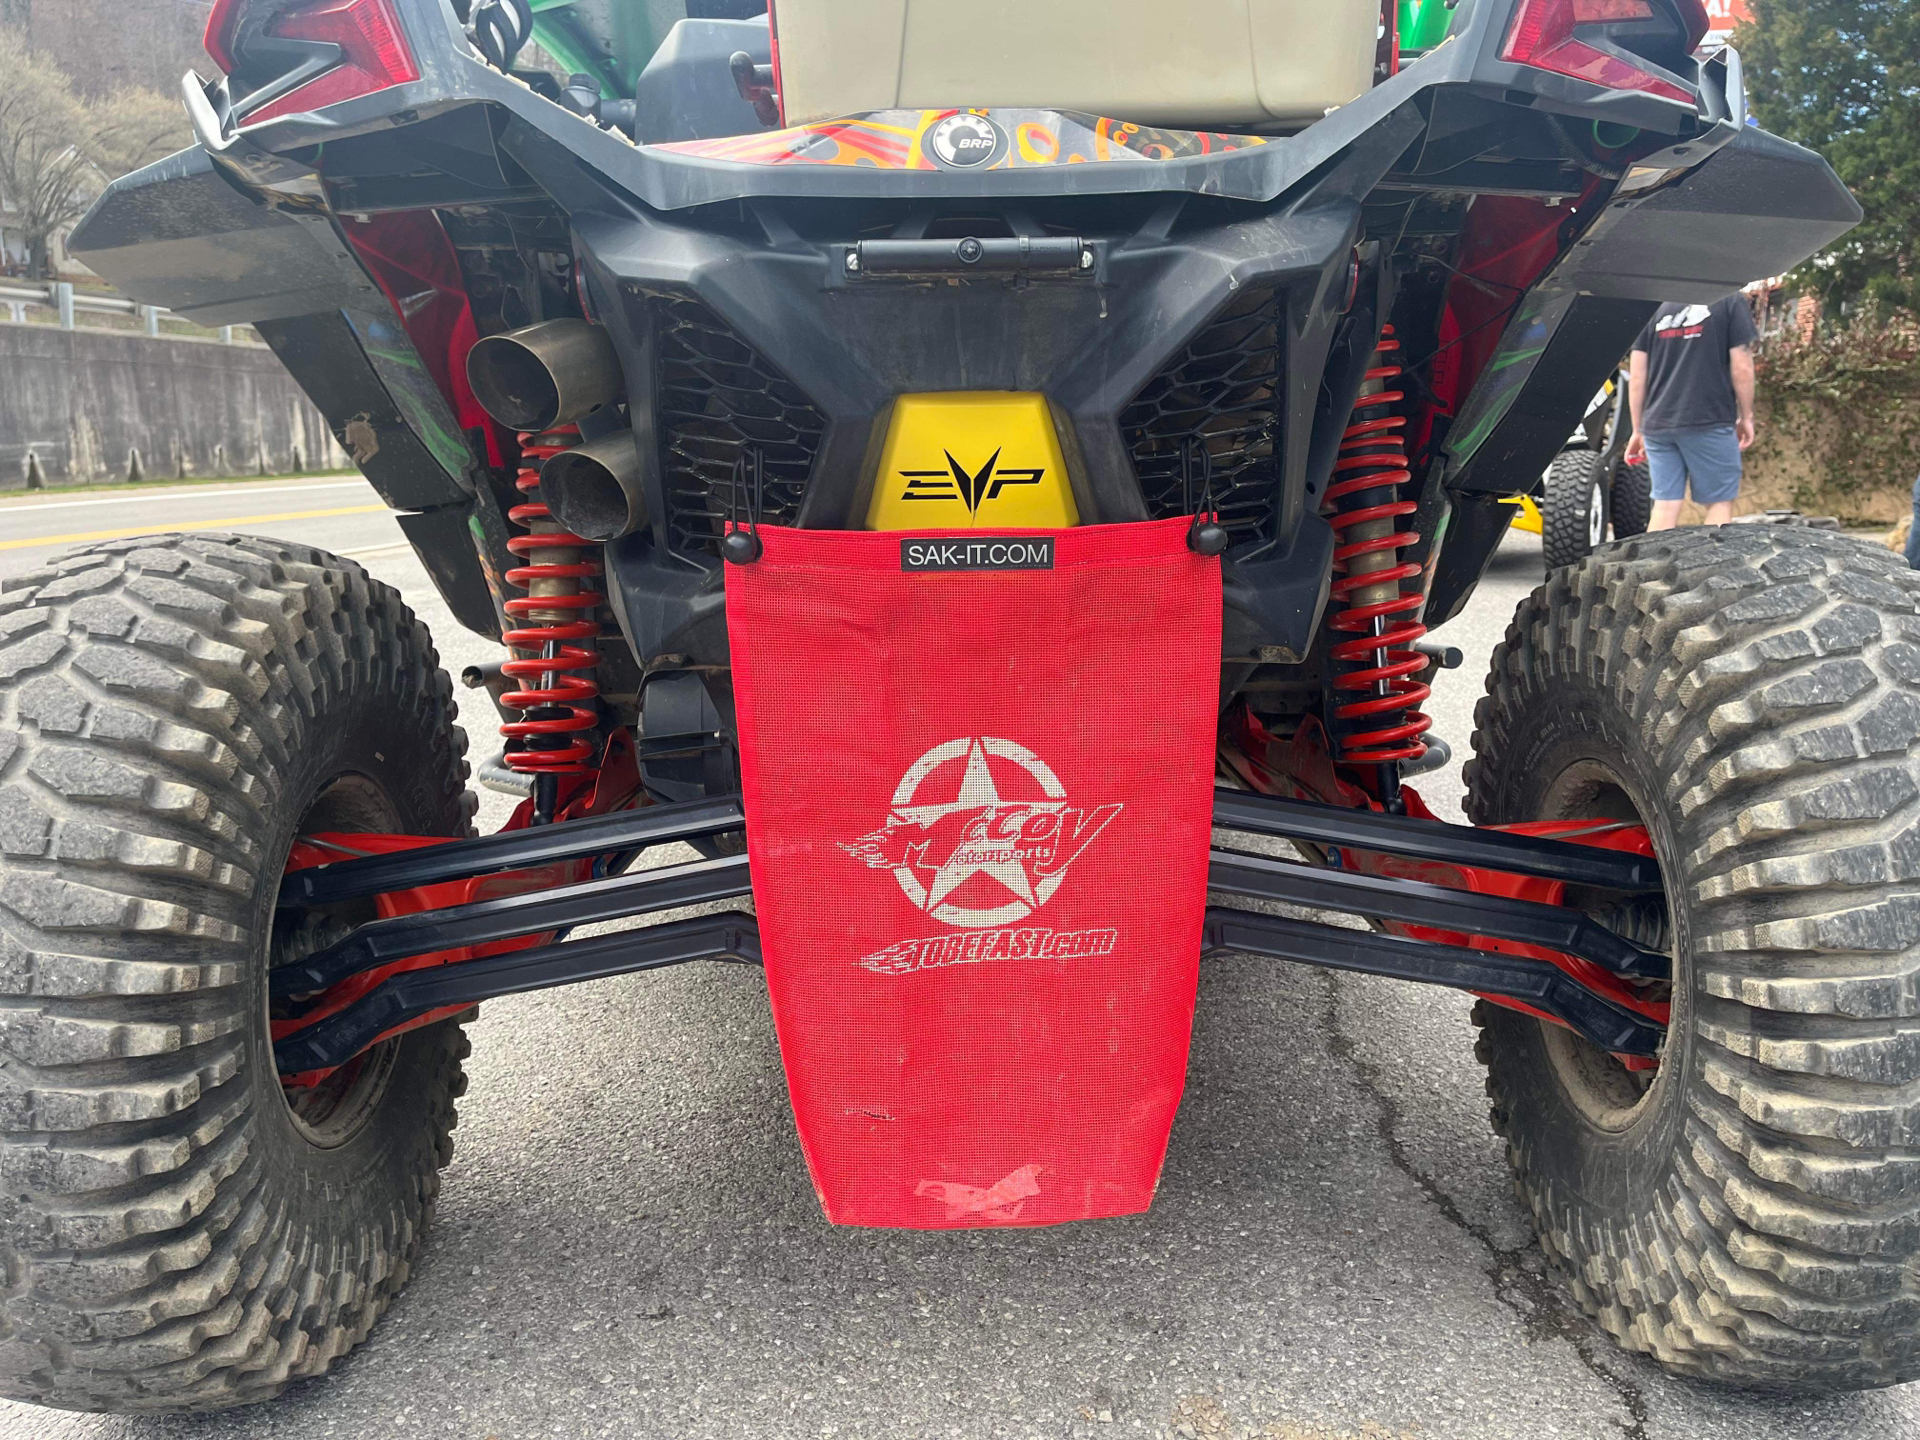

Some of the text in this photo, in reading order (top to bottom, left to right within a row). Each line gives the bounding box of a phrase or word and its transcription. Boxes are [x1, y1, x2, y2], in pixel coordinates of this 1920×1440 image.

[958, 138, 993, 149] BRP
[898, 446, 1045, 514] EVP
[908, 544, 1048, 566] SAK-IT.COM
